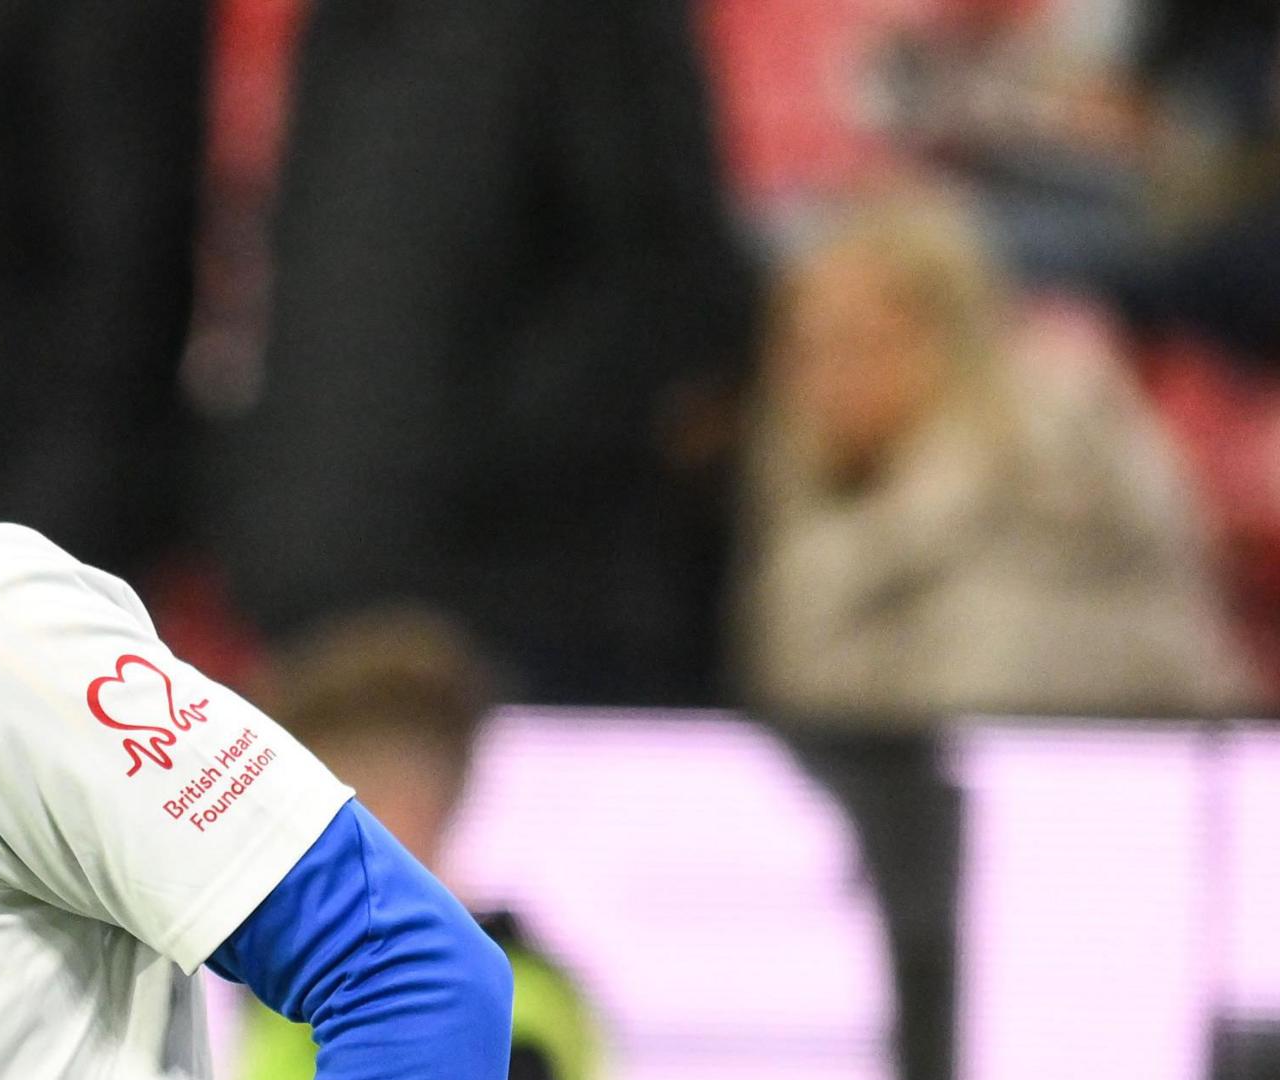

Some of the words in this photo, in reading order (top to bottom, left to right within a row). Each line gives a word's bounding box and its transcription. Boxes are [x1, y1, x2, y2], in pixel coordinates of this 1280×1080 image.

[162, 765, 222, 820] British
[215, 728, 258, 769] Heart
[189, 746, 277, 832] Foundation
